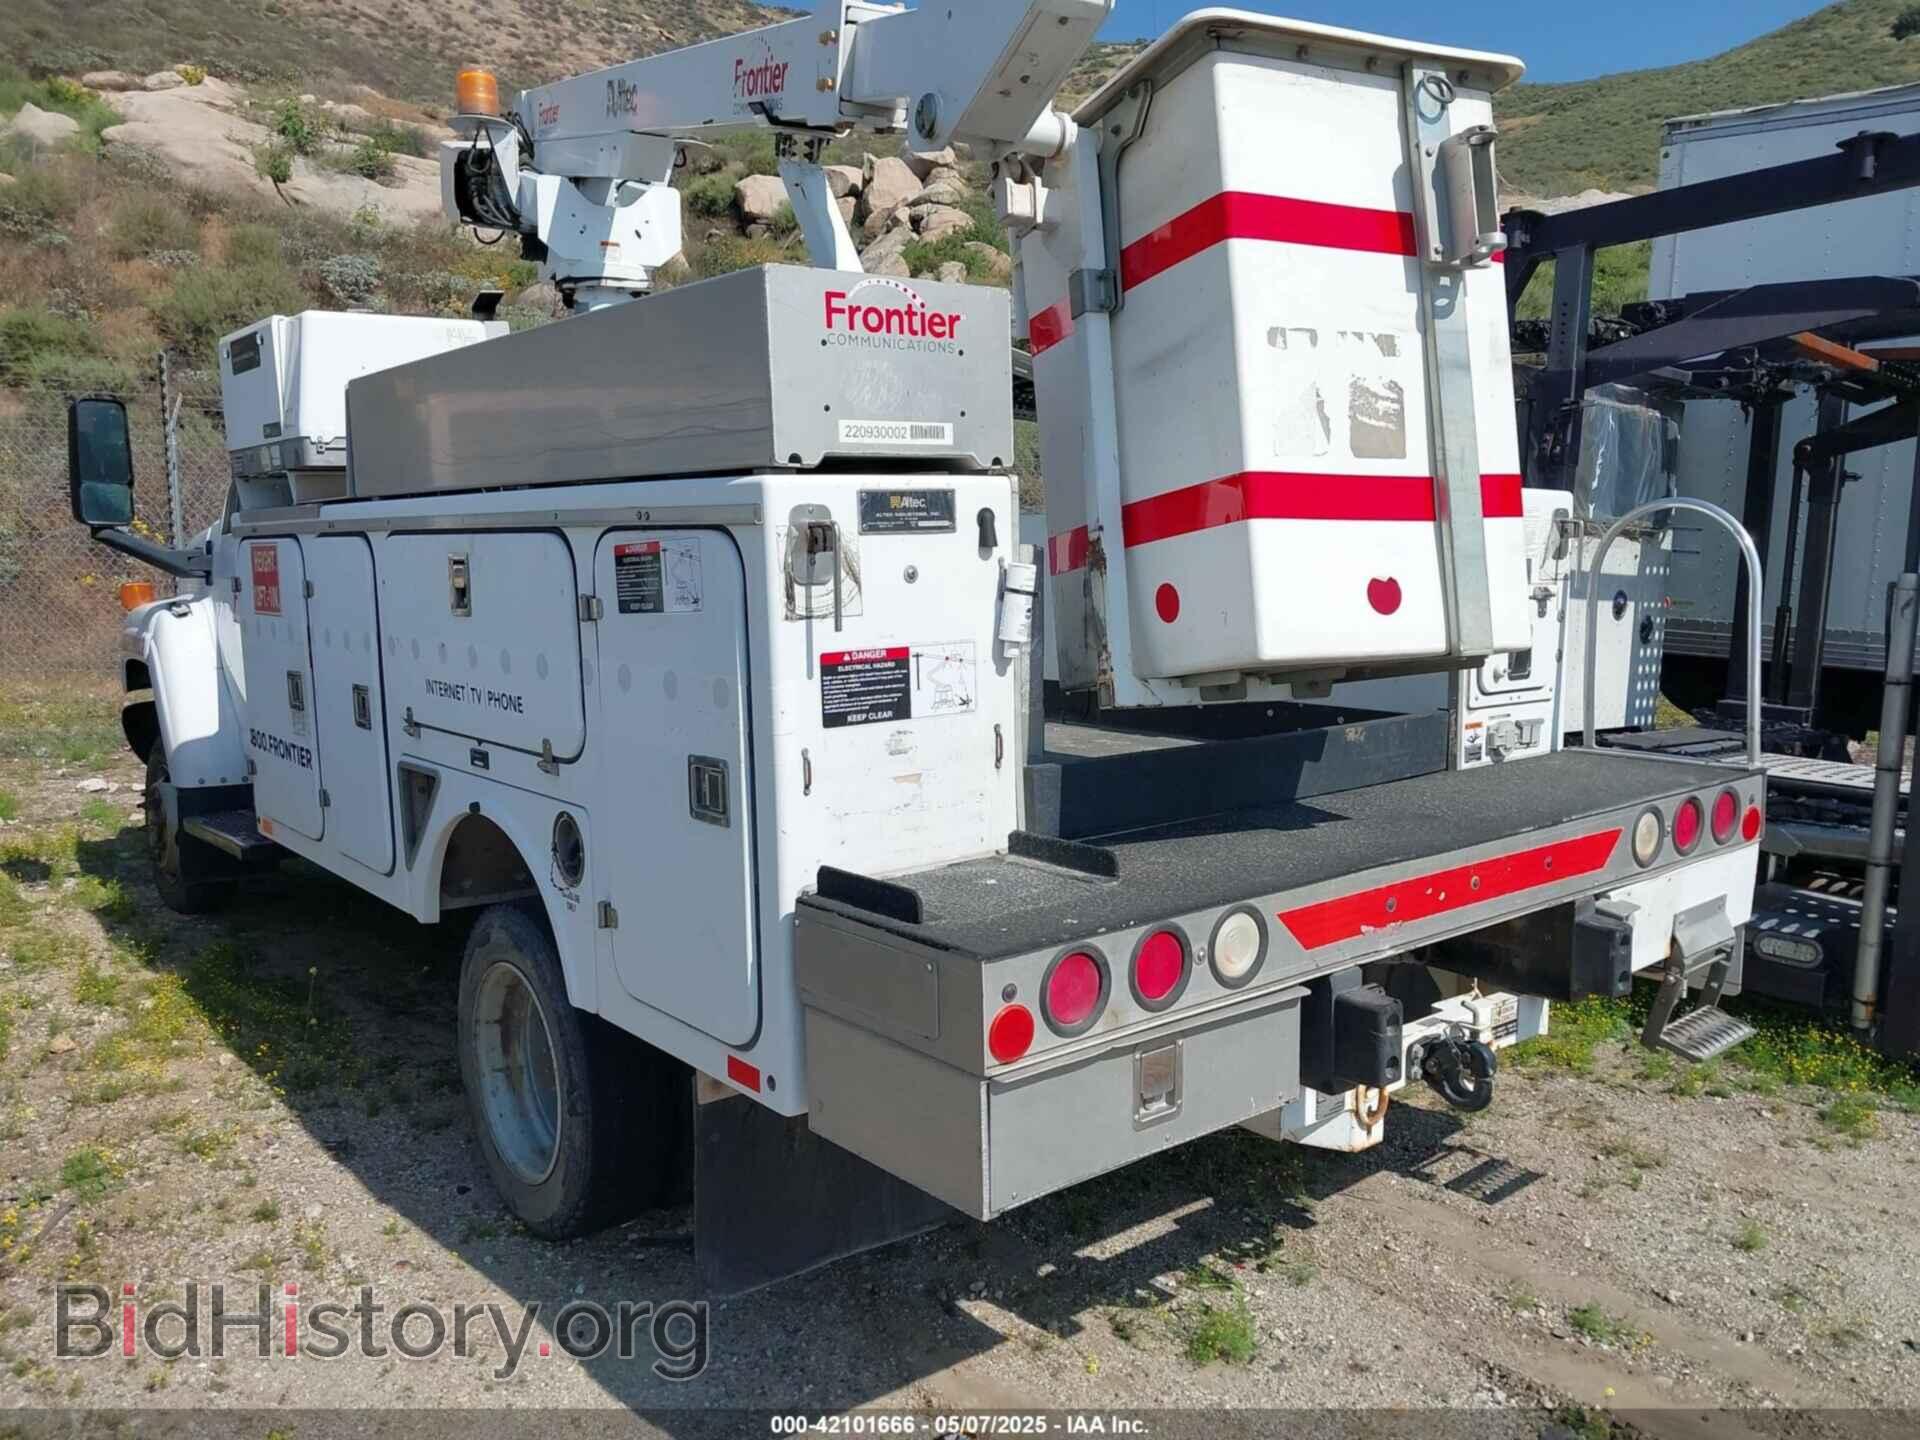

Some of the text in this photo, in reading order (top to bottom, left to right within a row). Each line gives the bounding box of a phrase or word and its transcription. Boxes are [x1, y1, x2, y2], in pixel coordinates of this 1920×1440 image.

[734, 56, 788, 98] Frontier
[825, 291, 961, 339] Frontier
[827, 333, 955, 354] COMMUNICATIONS
[845, 425, 908, 439] 220930002
[901, 496, 926, 508] Altec
[851, 650, 887, 660] DANGER
[425, 679, 523, 714] INTERNET TV PHONE
[847, 710, 893, 722] KEEP CLEAR
